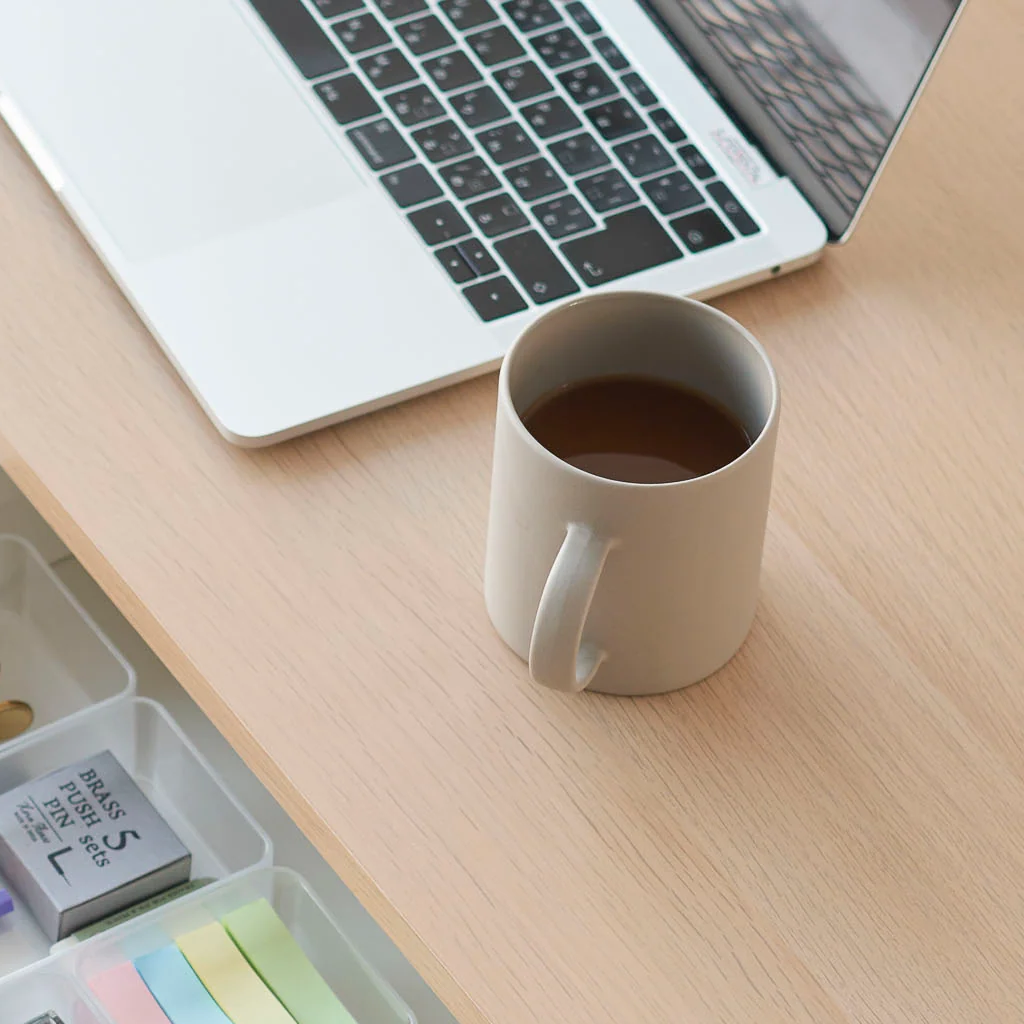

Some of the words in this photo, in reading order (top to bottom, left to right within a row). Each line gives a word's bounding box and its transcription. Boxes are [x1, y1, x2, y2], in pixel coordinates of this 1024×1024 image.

[42, 797, 75, 829] PIN
[59, 780, 102, 829] PUSH
[78, 768, 126, 820] BRASS
[78, 834, 110, 868] sets
